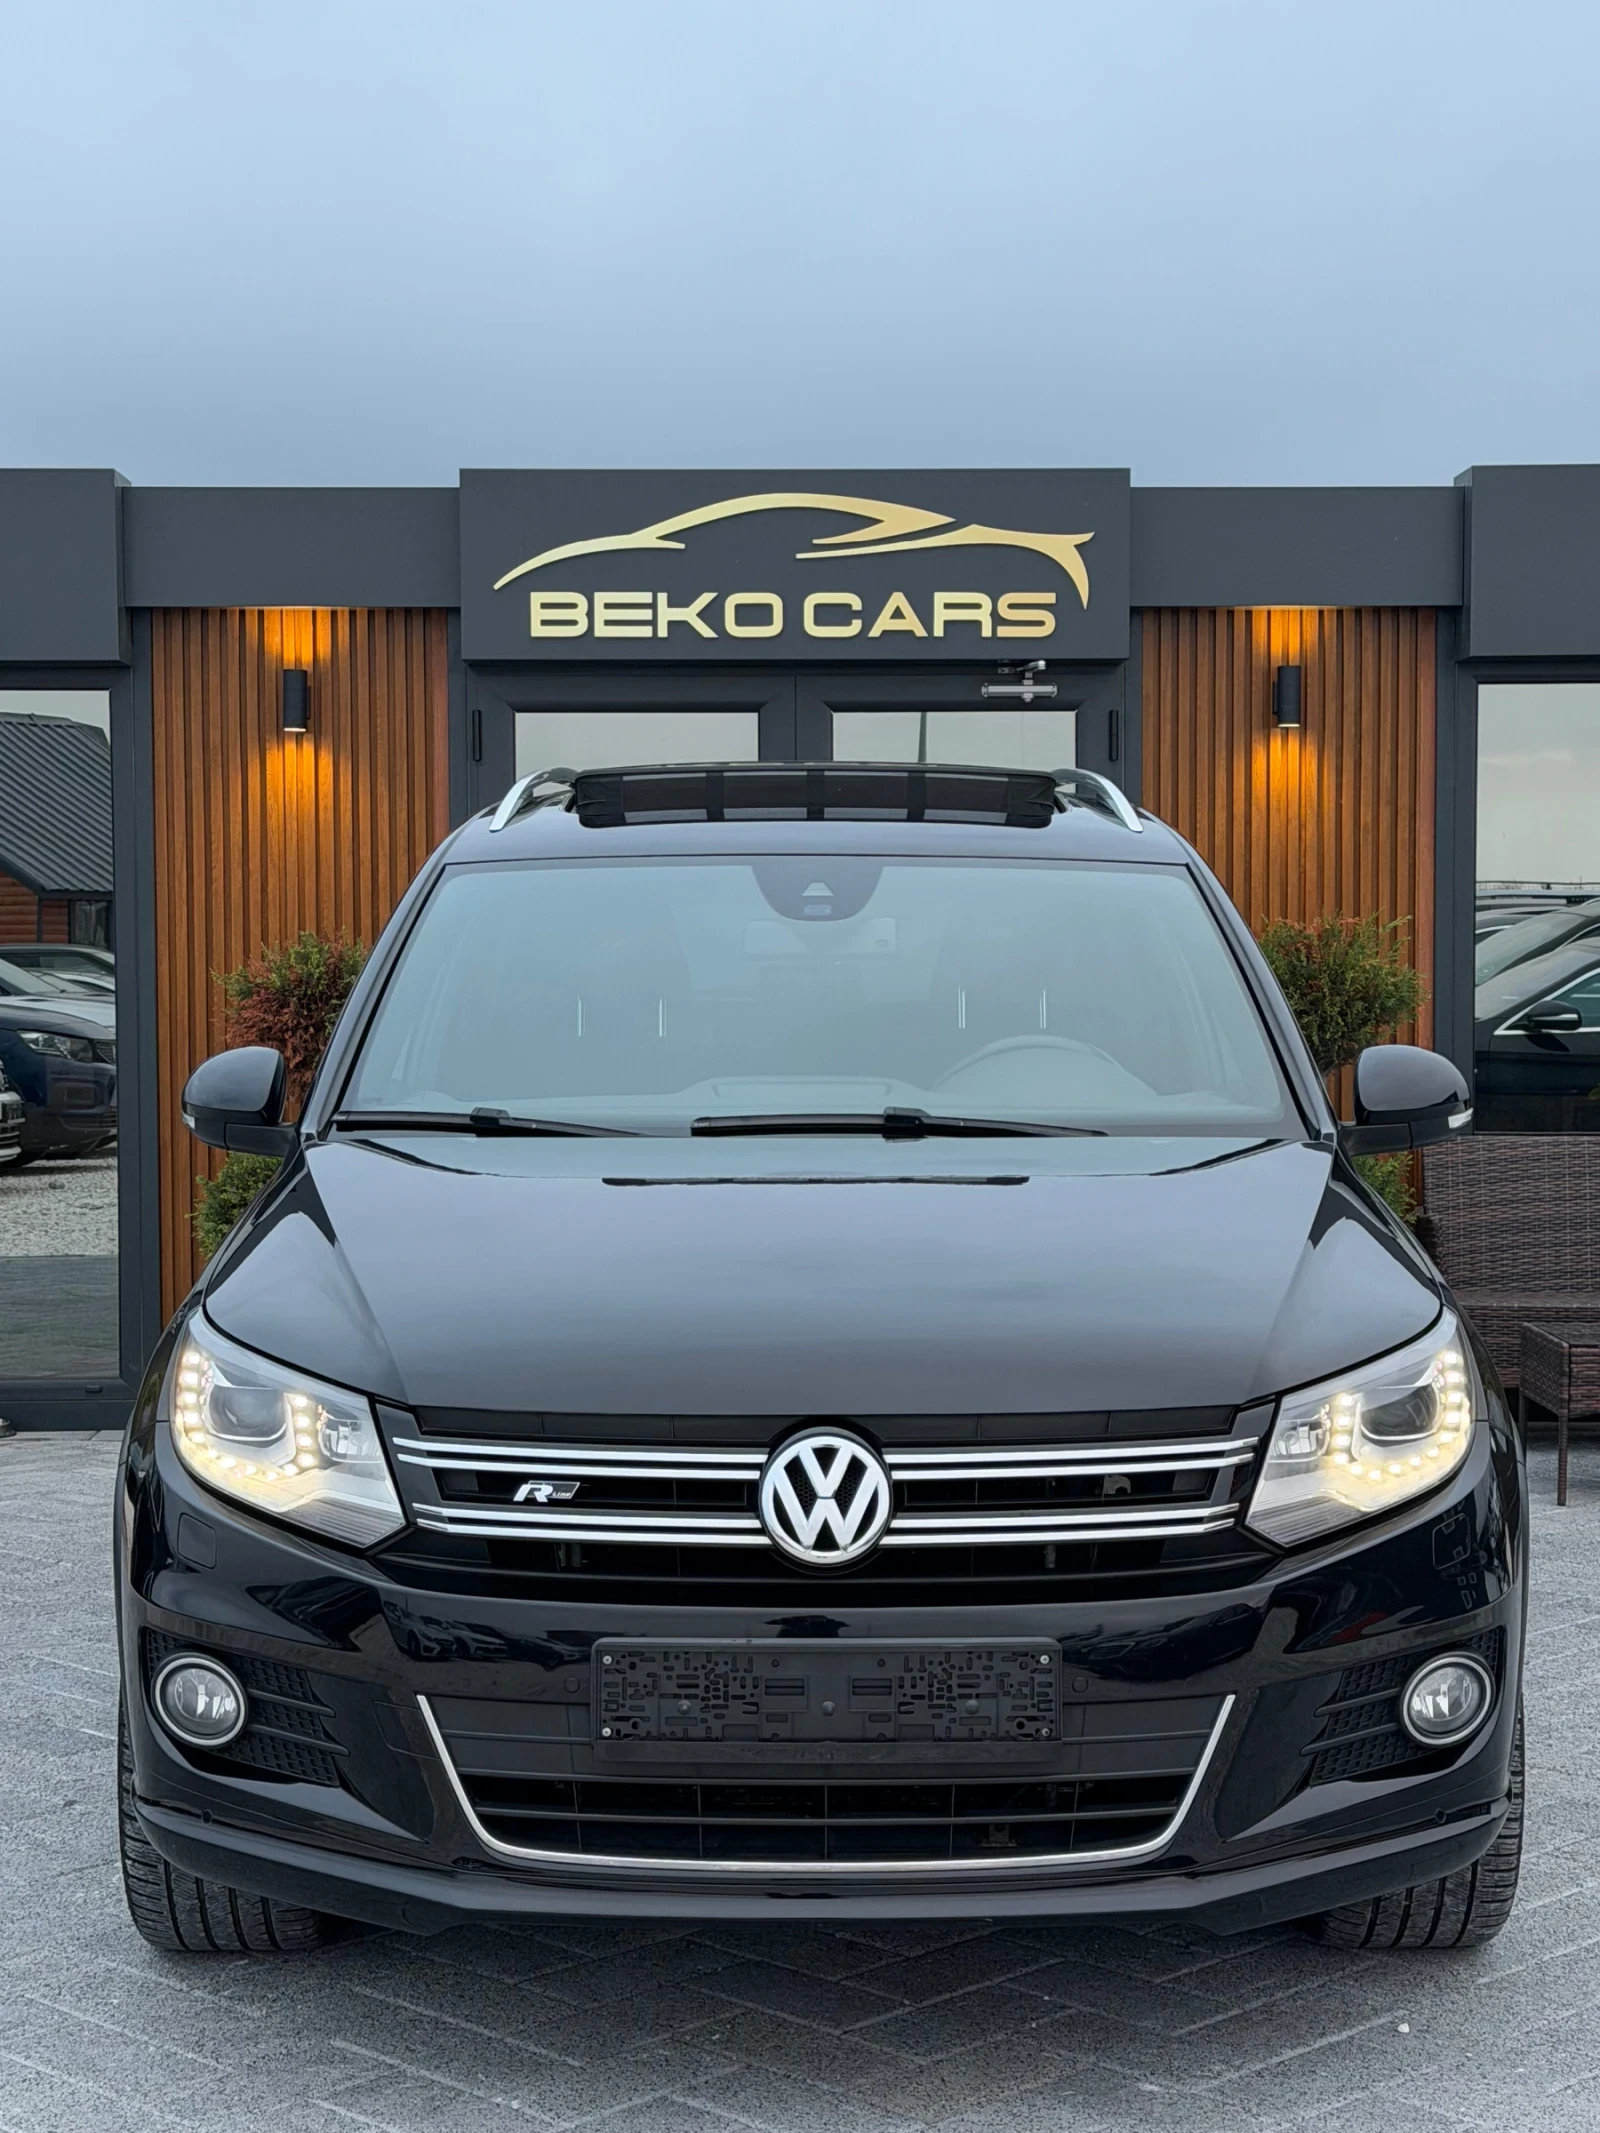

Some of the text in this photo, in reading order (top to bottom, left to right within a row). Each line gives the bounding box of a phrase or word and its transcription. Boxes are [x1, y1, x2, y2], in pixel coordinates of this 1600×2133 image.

[529, 591, 1056, 638] BEKO CARS
[513, 1484, 553, 1502] R
